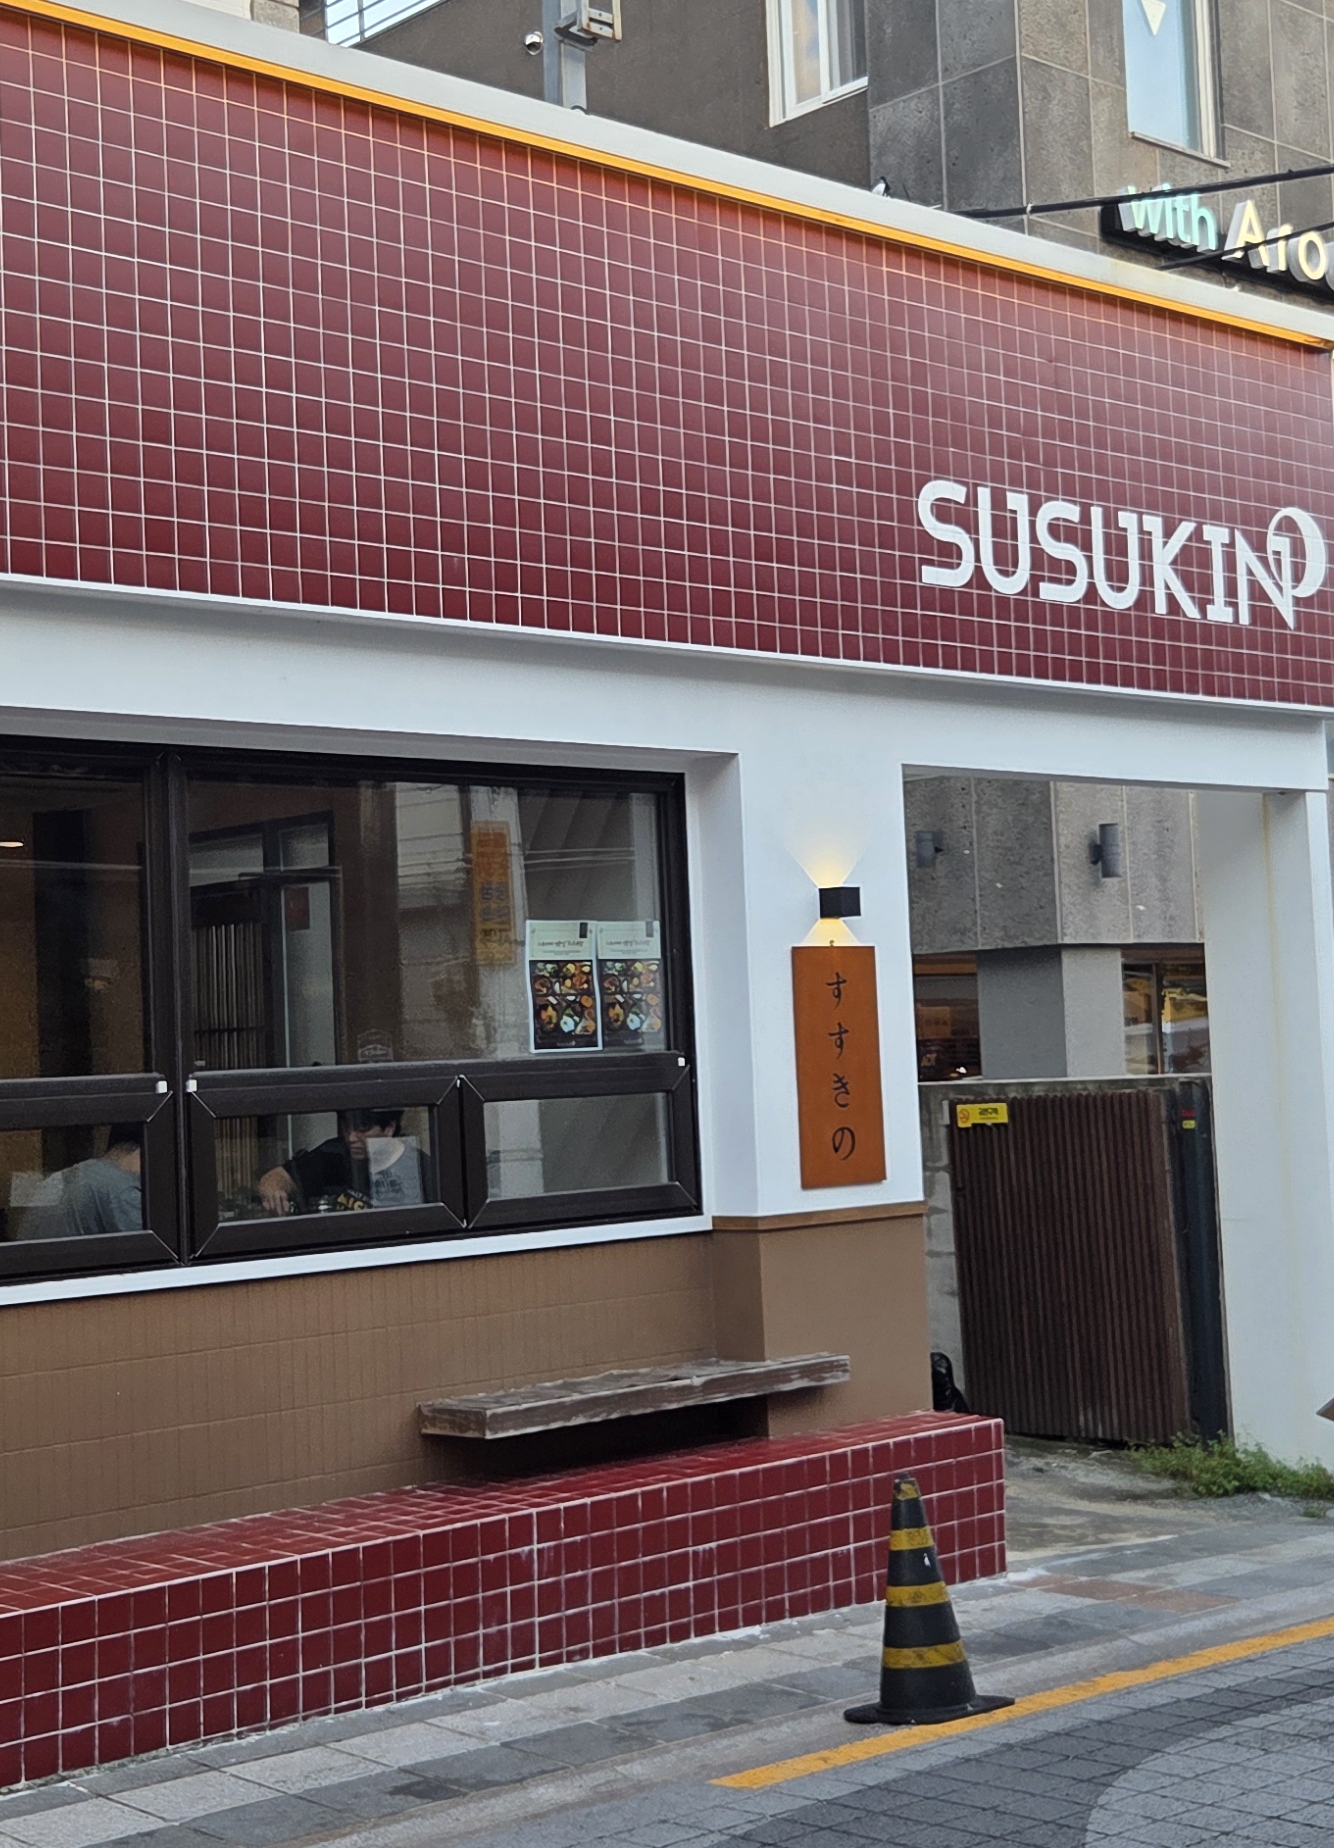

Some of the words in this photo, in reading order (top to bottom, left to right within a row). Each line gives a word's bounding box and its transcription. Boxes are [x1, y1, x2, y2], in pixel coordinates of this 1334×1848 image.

[1120, 184, 1217, 251] with
[917, 479, 1327, 631] SUSUKINO
[825, 971, 857, 1161] すすきの
